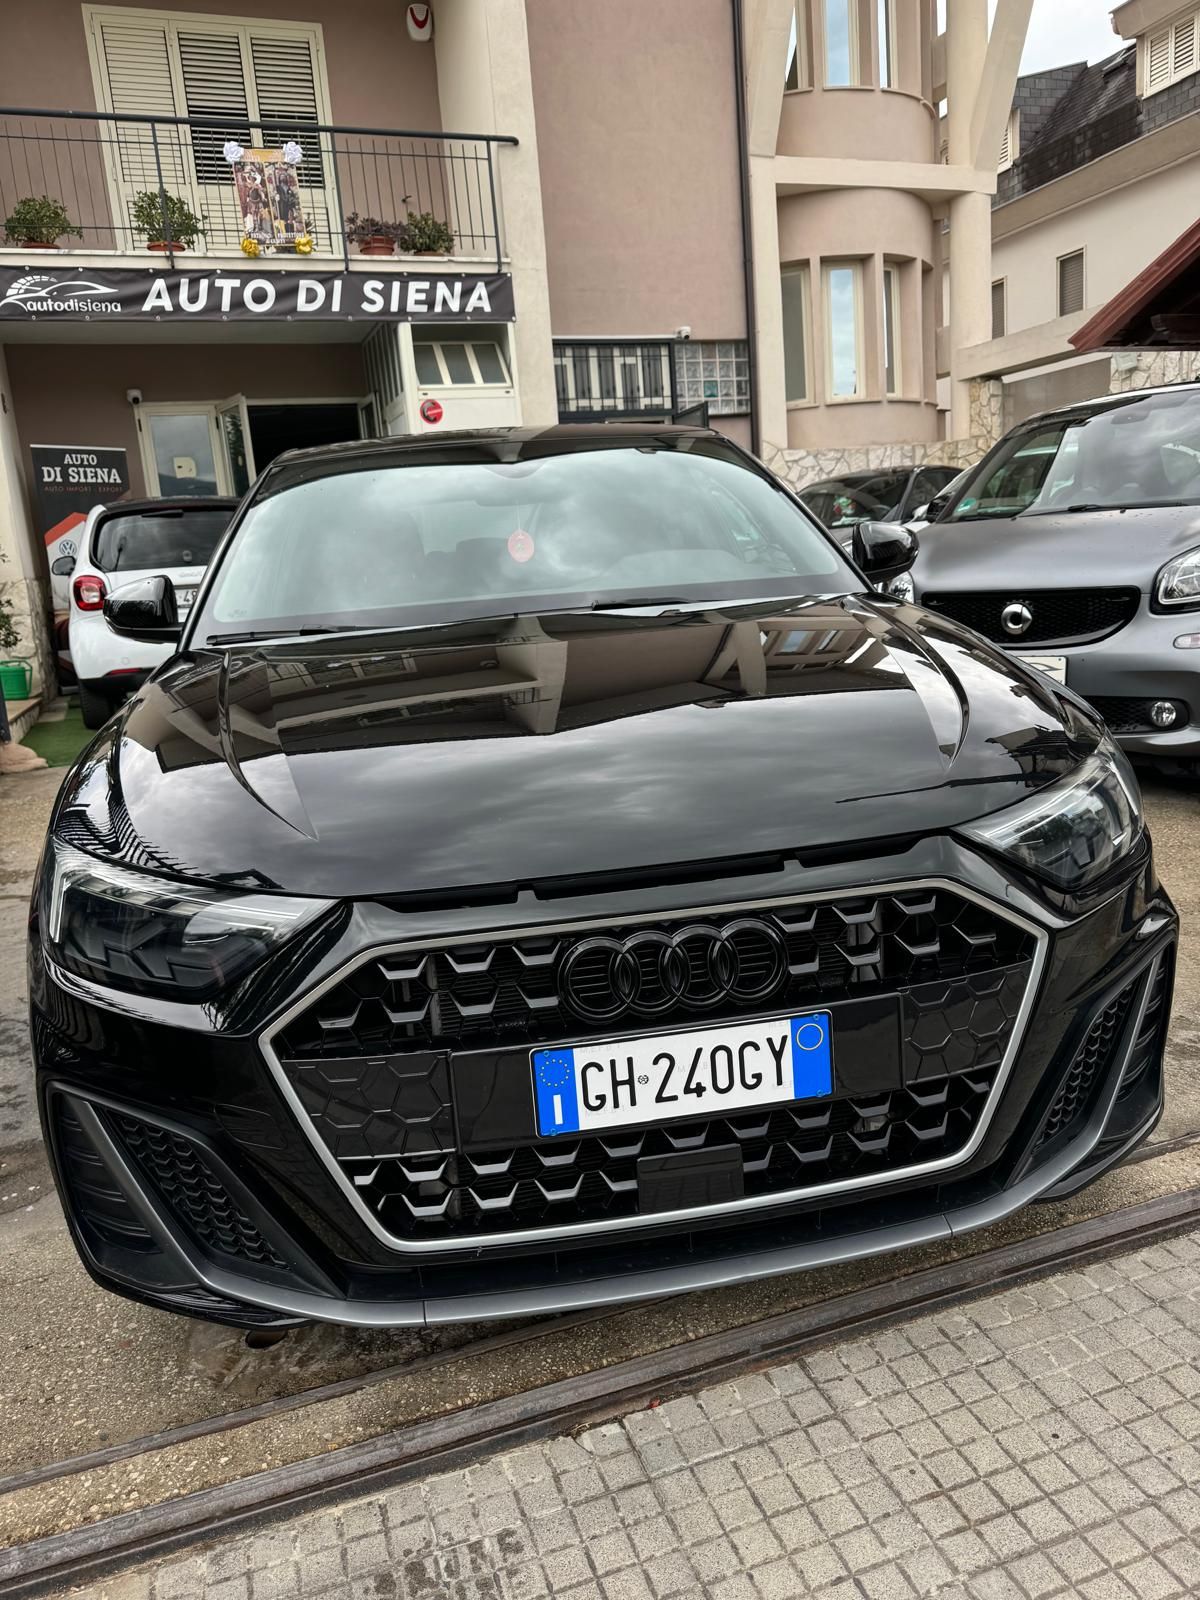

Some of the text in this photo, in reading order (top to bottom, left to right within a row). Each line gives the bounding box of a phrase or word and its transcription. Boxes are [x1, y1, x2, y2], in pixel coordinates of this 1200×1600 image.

[141, 277, 493, 314] AUTO DI SIENA
[26, 298, 122, 312] autodisiena
[63, 453, 98, 465] AUTO
[41, 466, 122, 483] DI SIENA
[65, 485, 92, 493] IMPORT
[580, 1034, 789, 1112] GH 240GY
